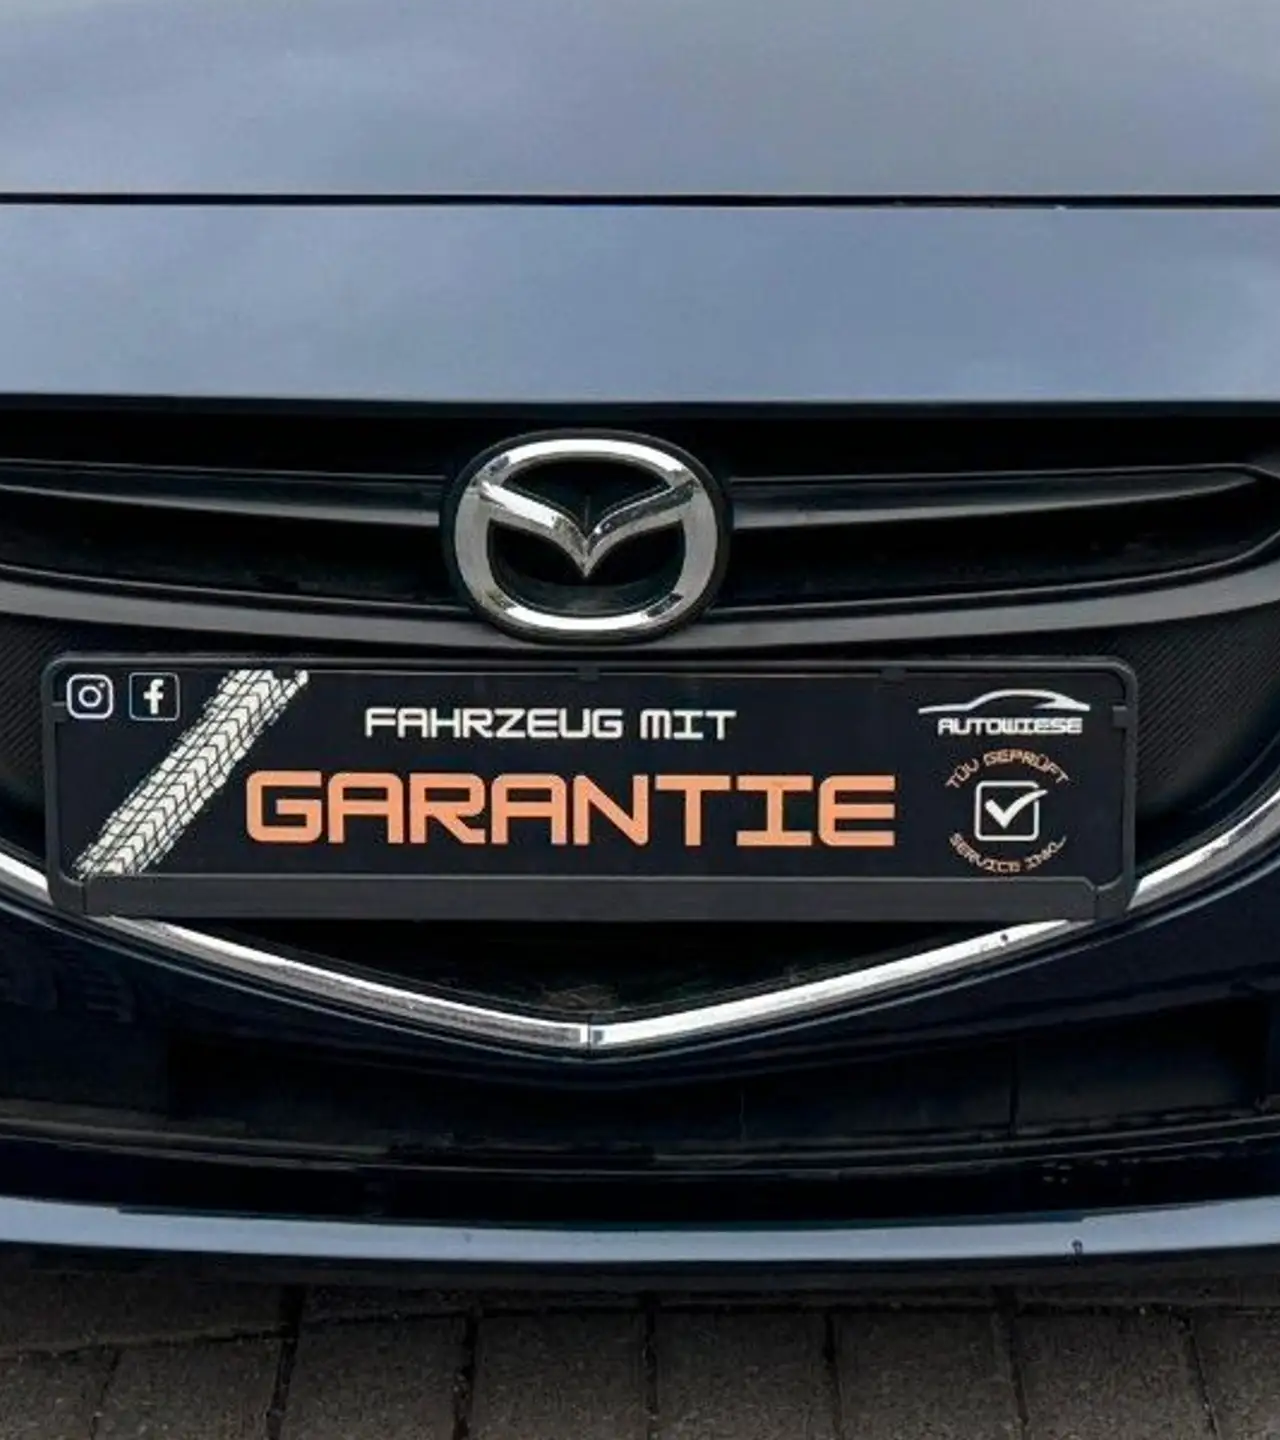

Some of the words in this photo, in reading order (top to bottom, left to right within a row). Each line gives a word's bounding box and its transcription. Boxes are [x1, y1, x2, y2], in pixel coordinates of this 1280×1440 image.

[364, 707, 624, 741] FAHRZEUG
[639, 707, 738, 741] MIT
[937, 716, 1083, 736] AUTOWIESE
[983, 748, 1070, 785] GEPRÜFT
[245, 772, 897, 848] GARANTIE
[948, 831, 1022, 874] SERVICE
